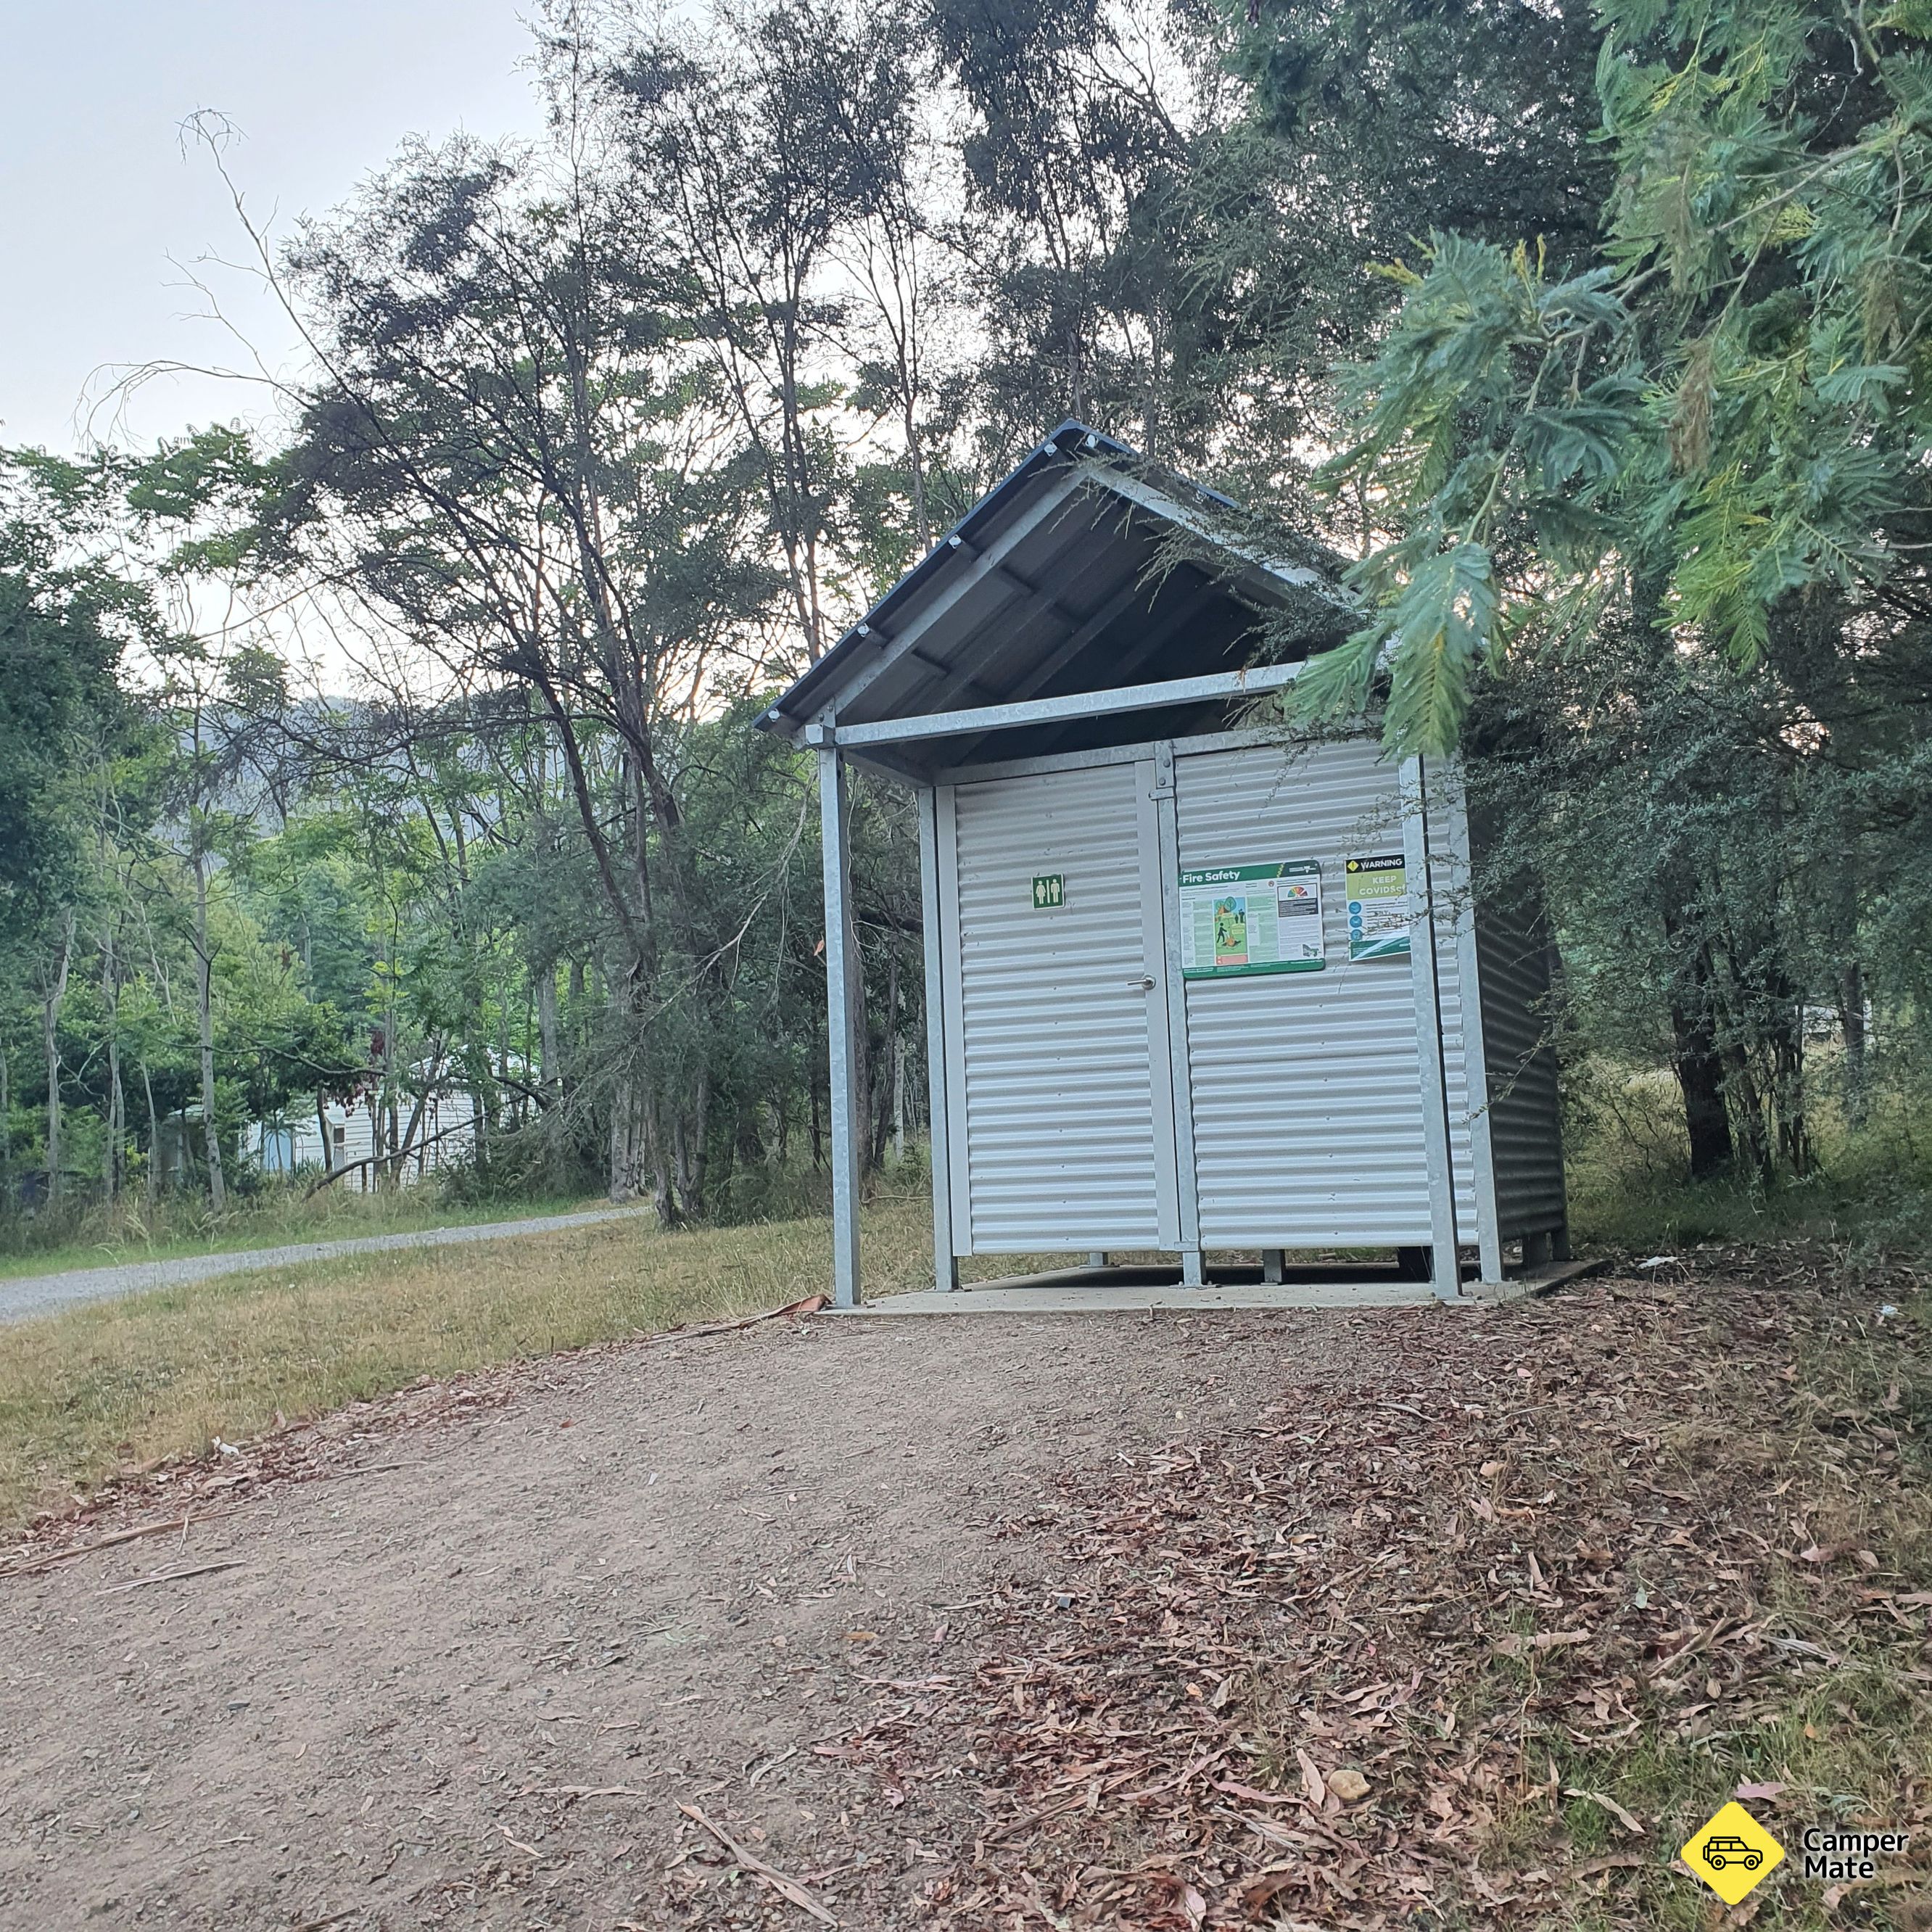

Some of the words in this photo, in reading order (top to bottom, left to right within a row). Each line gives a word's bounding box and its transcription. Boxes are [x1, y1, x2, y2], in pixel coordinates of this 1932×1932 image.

[1361, 858, 1403, 870] WARNING
[1182, 873, 1203, 883] Fire
[1205, 870, 1241, 881] Safety
[1372, 875, 1397, 884] KEEP
